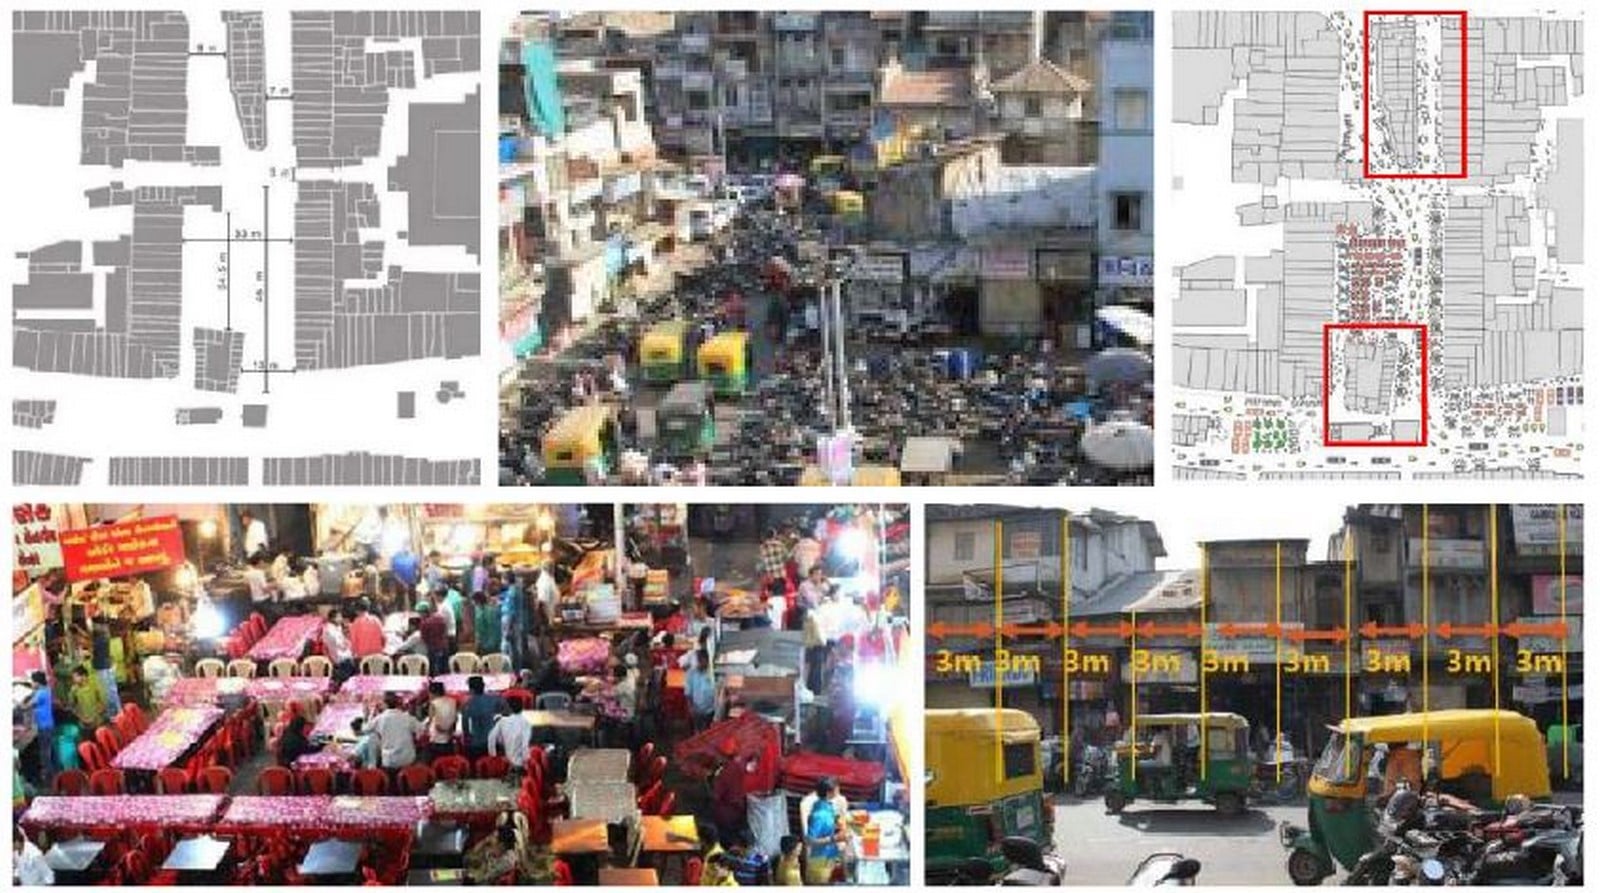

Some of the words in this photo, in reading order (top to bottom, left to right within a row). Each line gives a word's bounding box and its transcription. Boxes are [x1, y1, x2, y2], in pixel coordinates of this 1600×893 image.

[269, 86, 276, 94] 7
[251, 230, 262, 238] m
[219, 251, 227, 263] m
[255, 271, 263, 282] m
